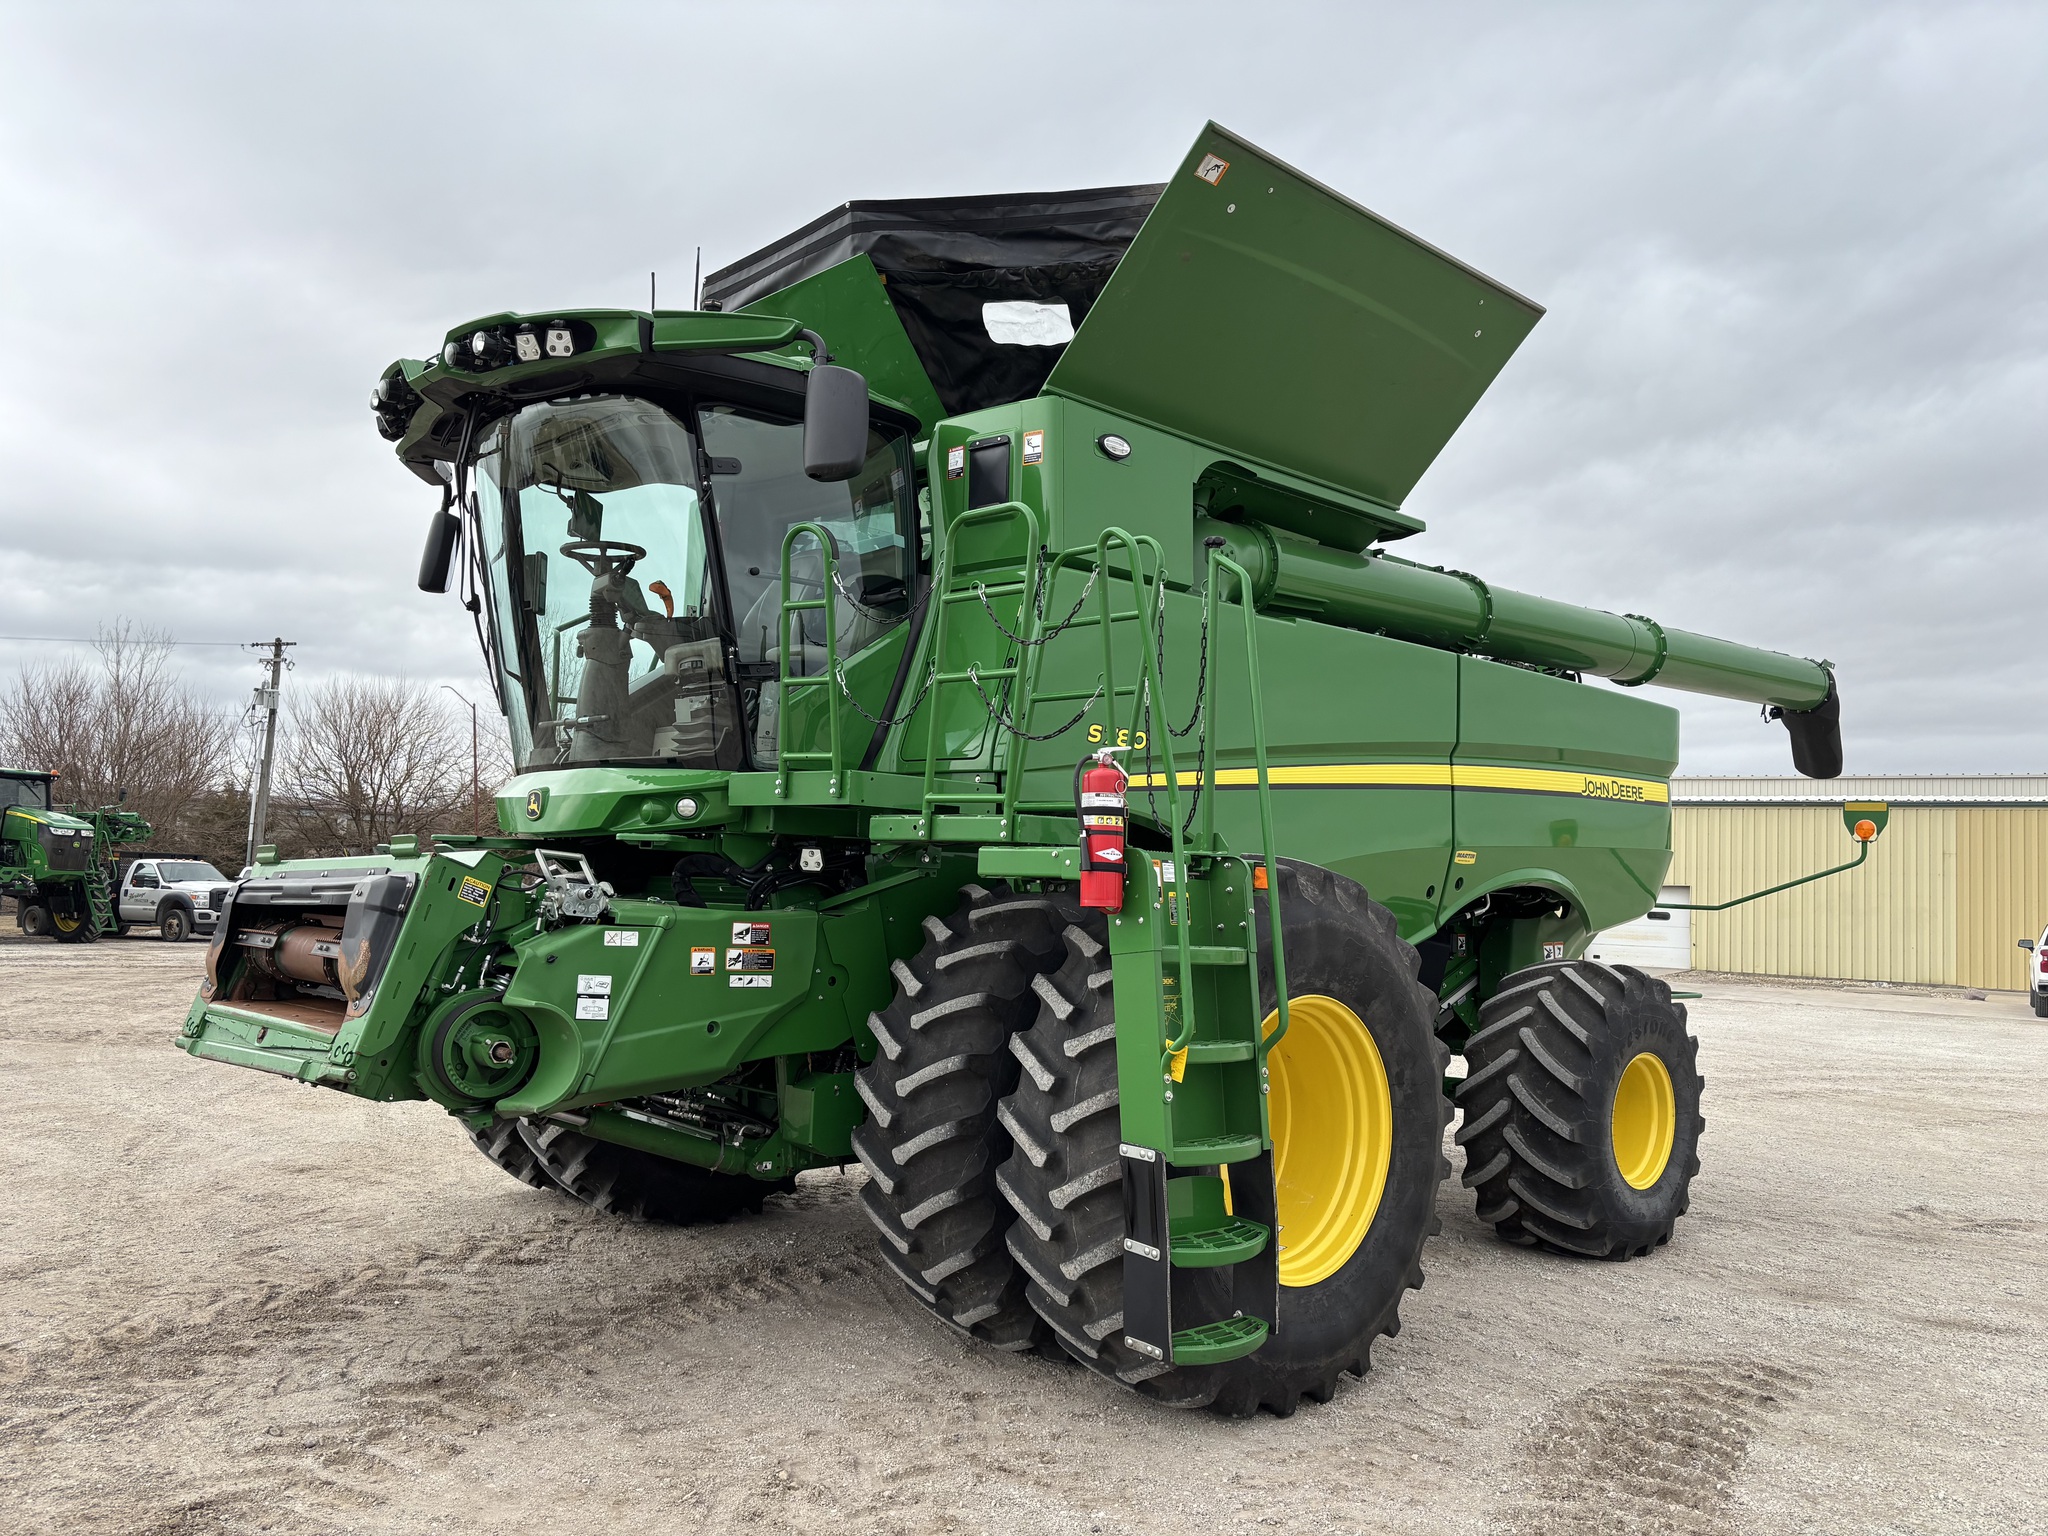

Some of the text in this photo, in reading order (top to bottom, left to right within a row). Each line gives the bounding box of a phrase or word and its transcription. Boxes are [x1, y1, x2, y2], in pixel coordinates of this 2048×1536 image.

[1087, 723, 1148, 750] S80
[1581, 777, 1644, 800] JOHN DEERE
[469, 878, 490, 890] CAUTION
